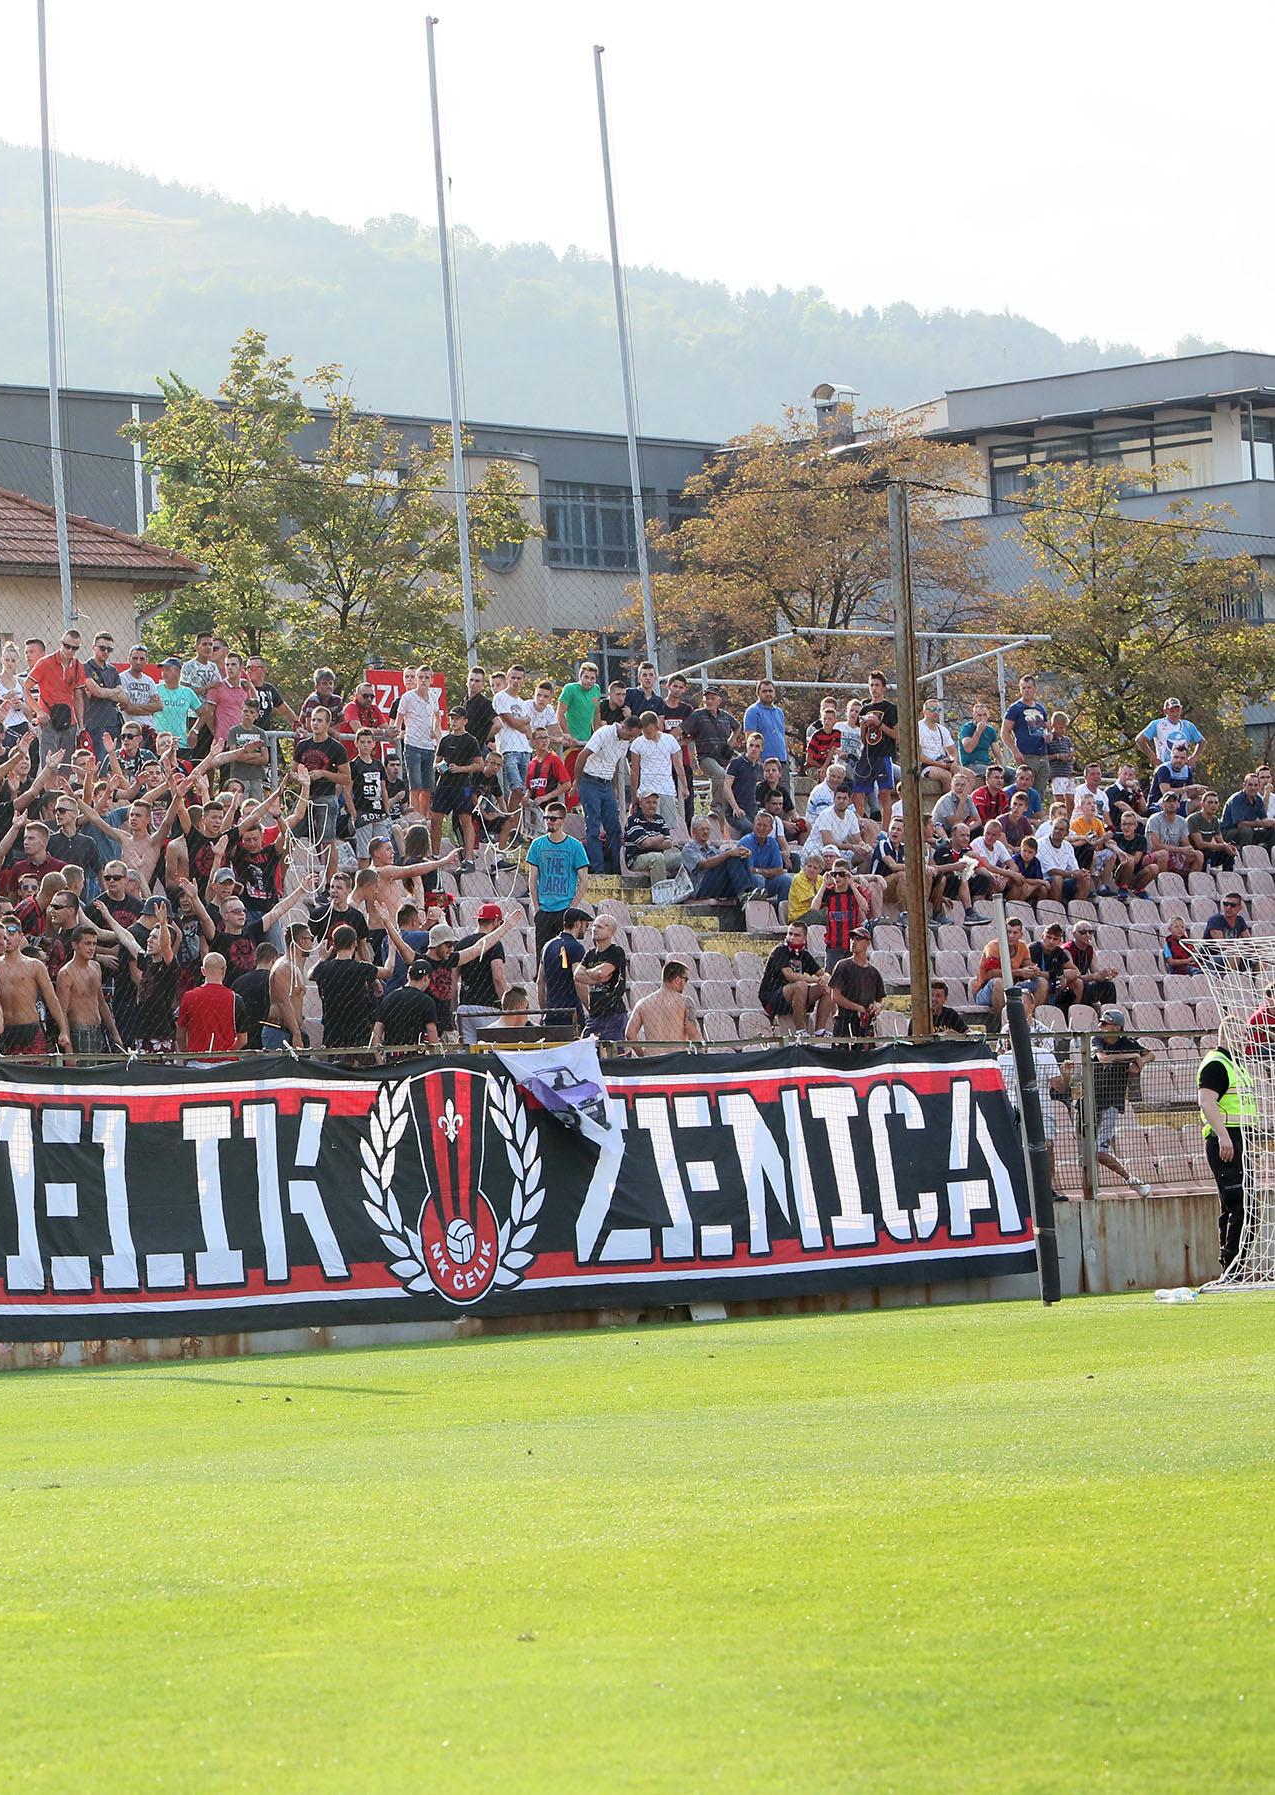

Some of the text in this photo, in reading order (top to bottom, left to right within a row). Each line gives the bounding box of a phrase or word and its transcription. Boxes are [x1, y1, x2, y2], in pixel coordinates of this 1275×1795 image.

[558, 945, 569, 969] 1
[575, 1080, 1022, 1263] ZENICA
[430, 1239, 493, 1291] NK ČELIK
